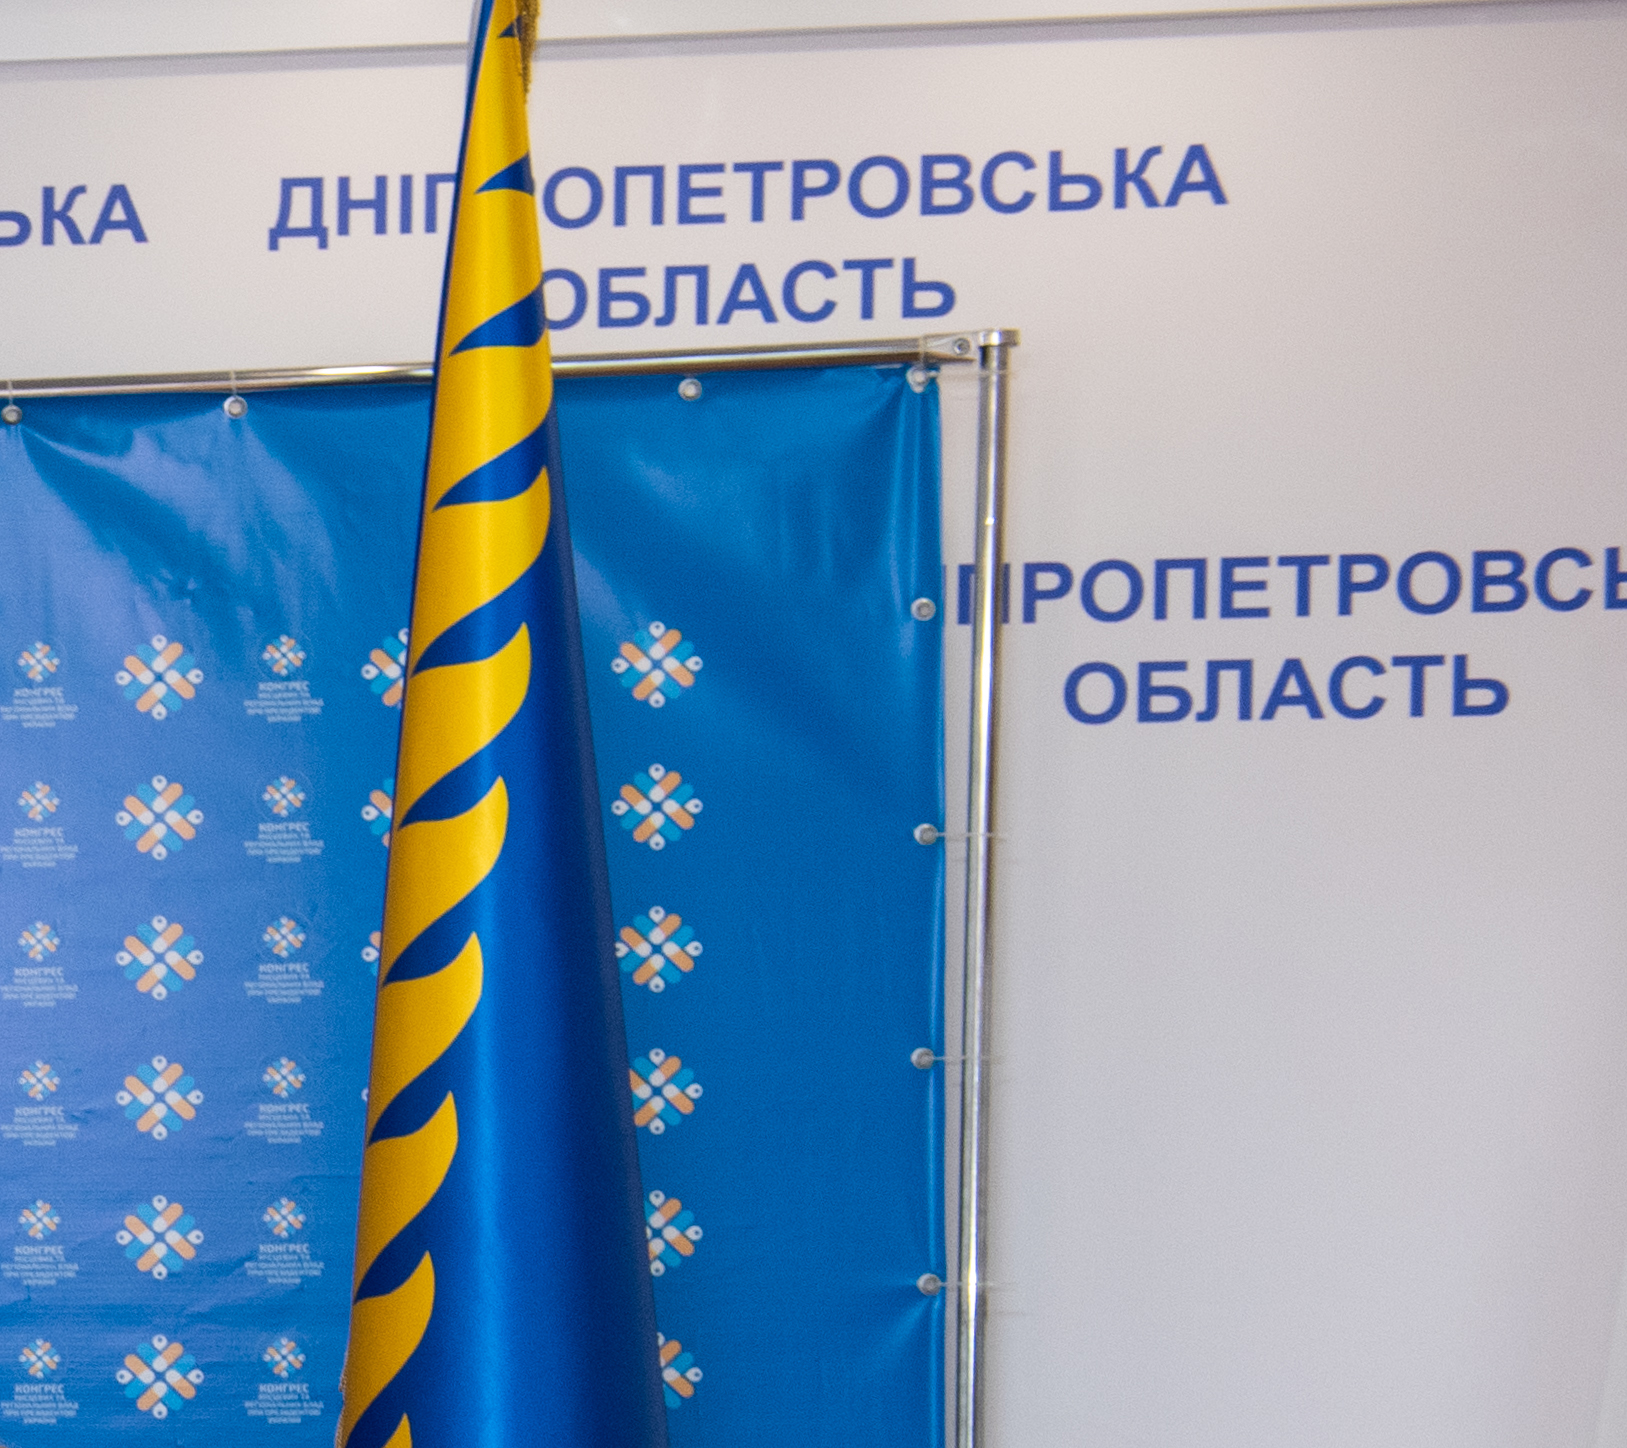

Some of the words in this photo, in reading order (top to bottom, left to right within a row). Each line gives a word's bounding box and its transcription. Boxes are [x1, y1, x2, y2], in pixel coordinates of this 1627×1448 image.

[268, 143, 1227, 251] ДНІПОПЕТРОВСЬКА
[542, 257, 955, 332] ОБЛАСТЬ
[1063, 654, 1509, 725] ОБЛАСТЬ
